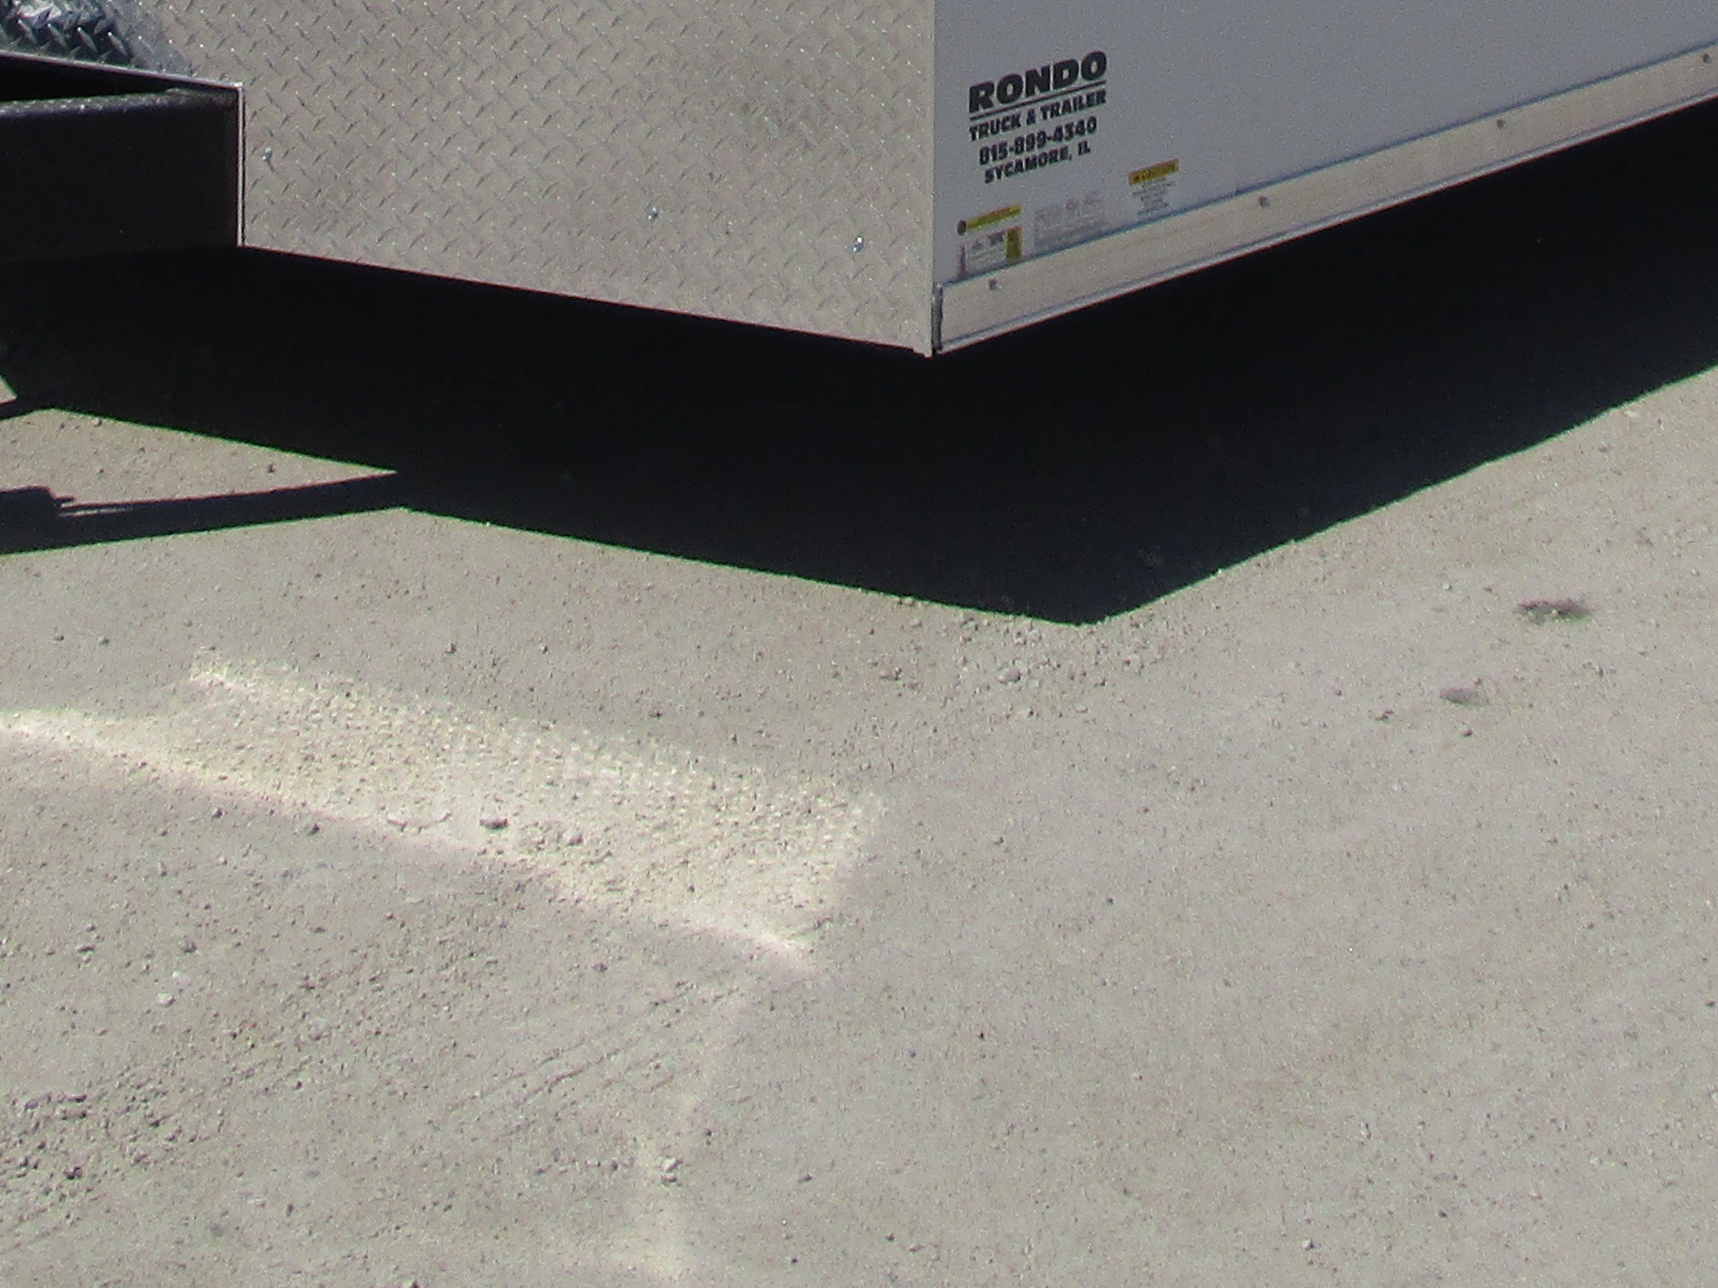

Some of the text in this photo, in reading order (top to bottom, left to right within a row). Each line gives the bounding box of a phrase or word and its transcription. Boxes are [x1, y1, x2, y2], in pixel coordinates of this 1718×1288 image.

[968, 50, 1108, 114] RONDO
[969, 88, 1107, 142] TRUCK & TRAILER
[984, 140, 1091, 185] SYCAMORE, IL
